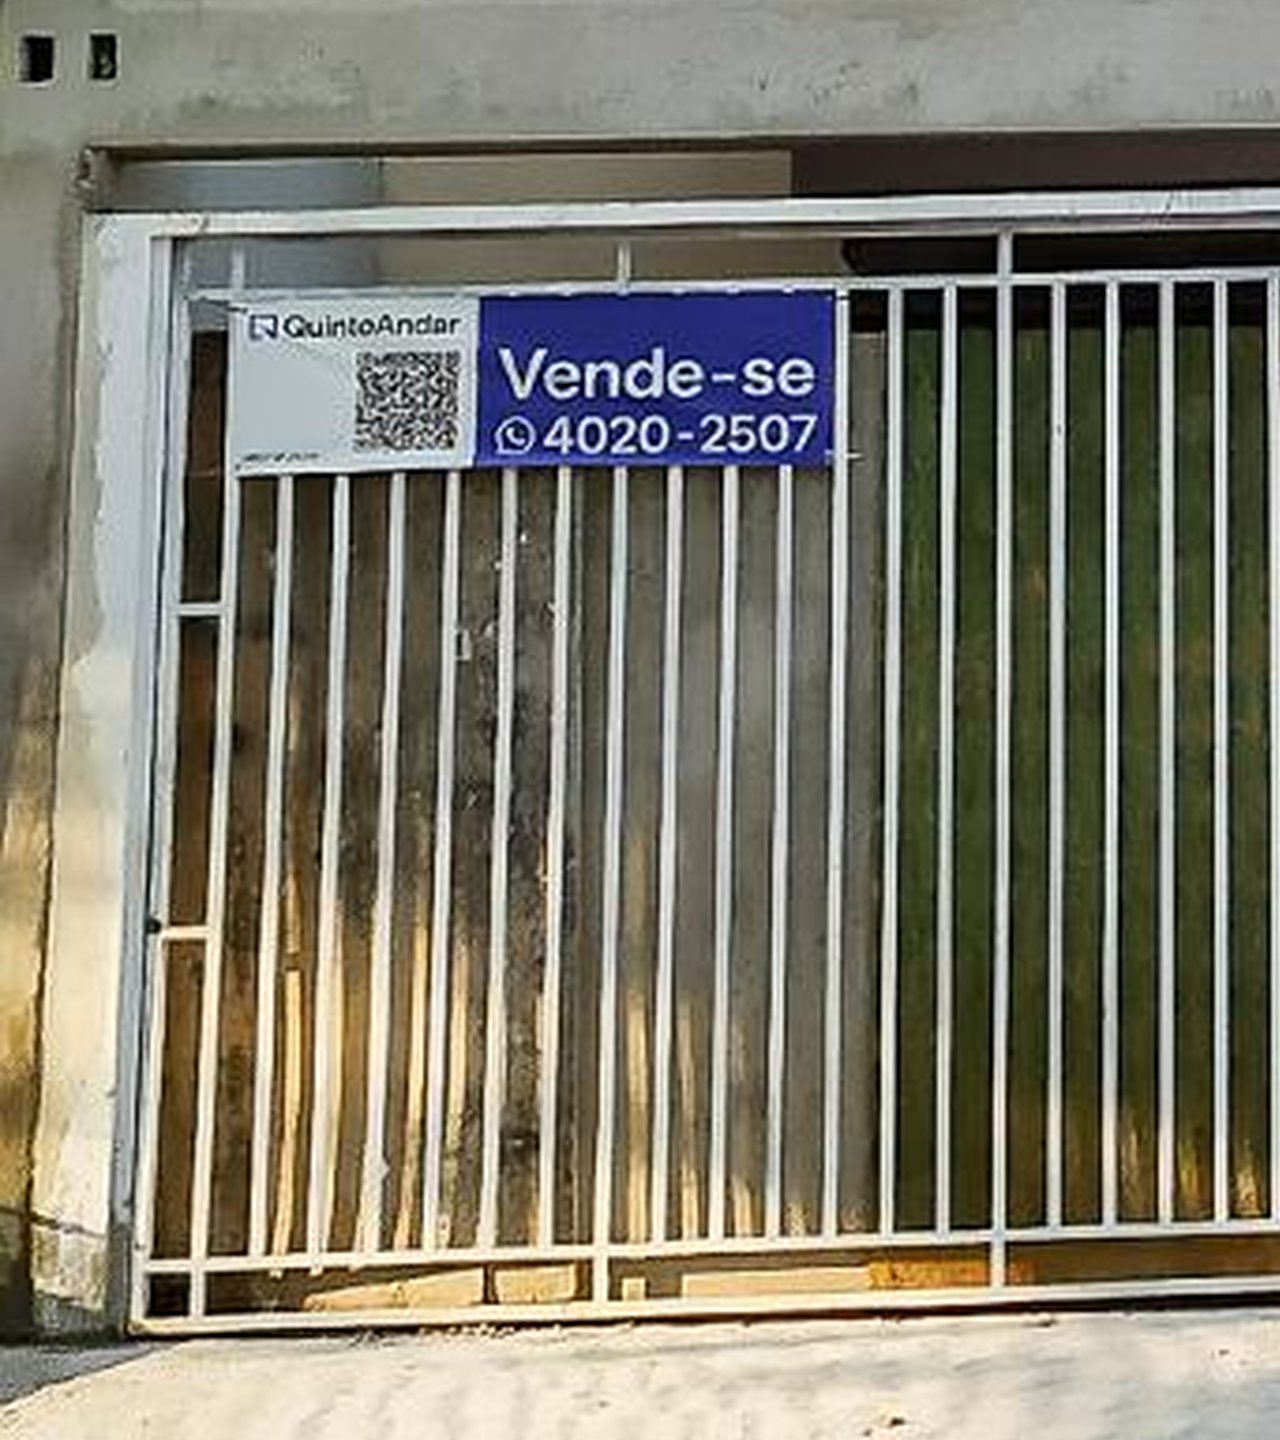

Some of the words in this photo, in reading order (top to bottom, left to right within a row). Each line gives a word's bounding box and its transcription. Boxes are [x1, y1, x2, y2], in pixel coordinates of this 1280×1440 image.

[282, 314, 461, 339] QuintoAndar
[499, 347, 816, 399] Vende-se
[544, 415, 817, 455] 4020-2507
